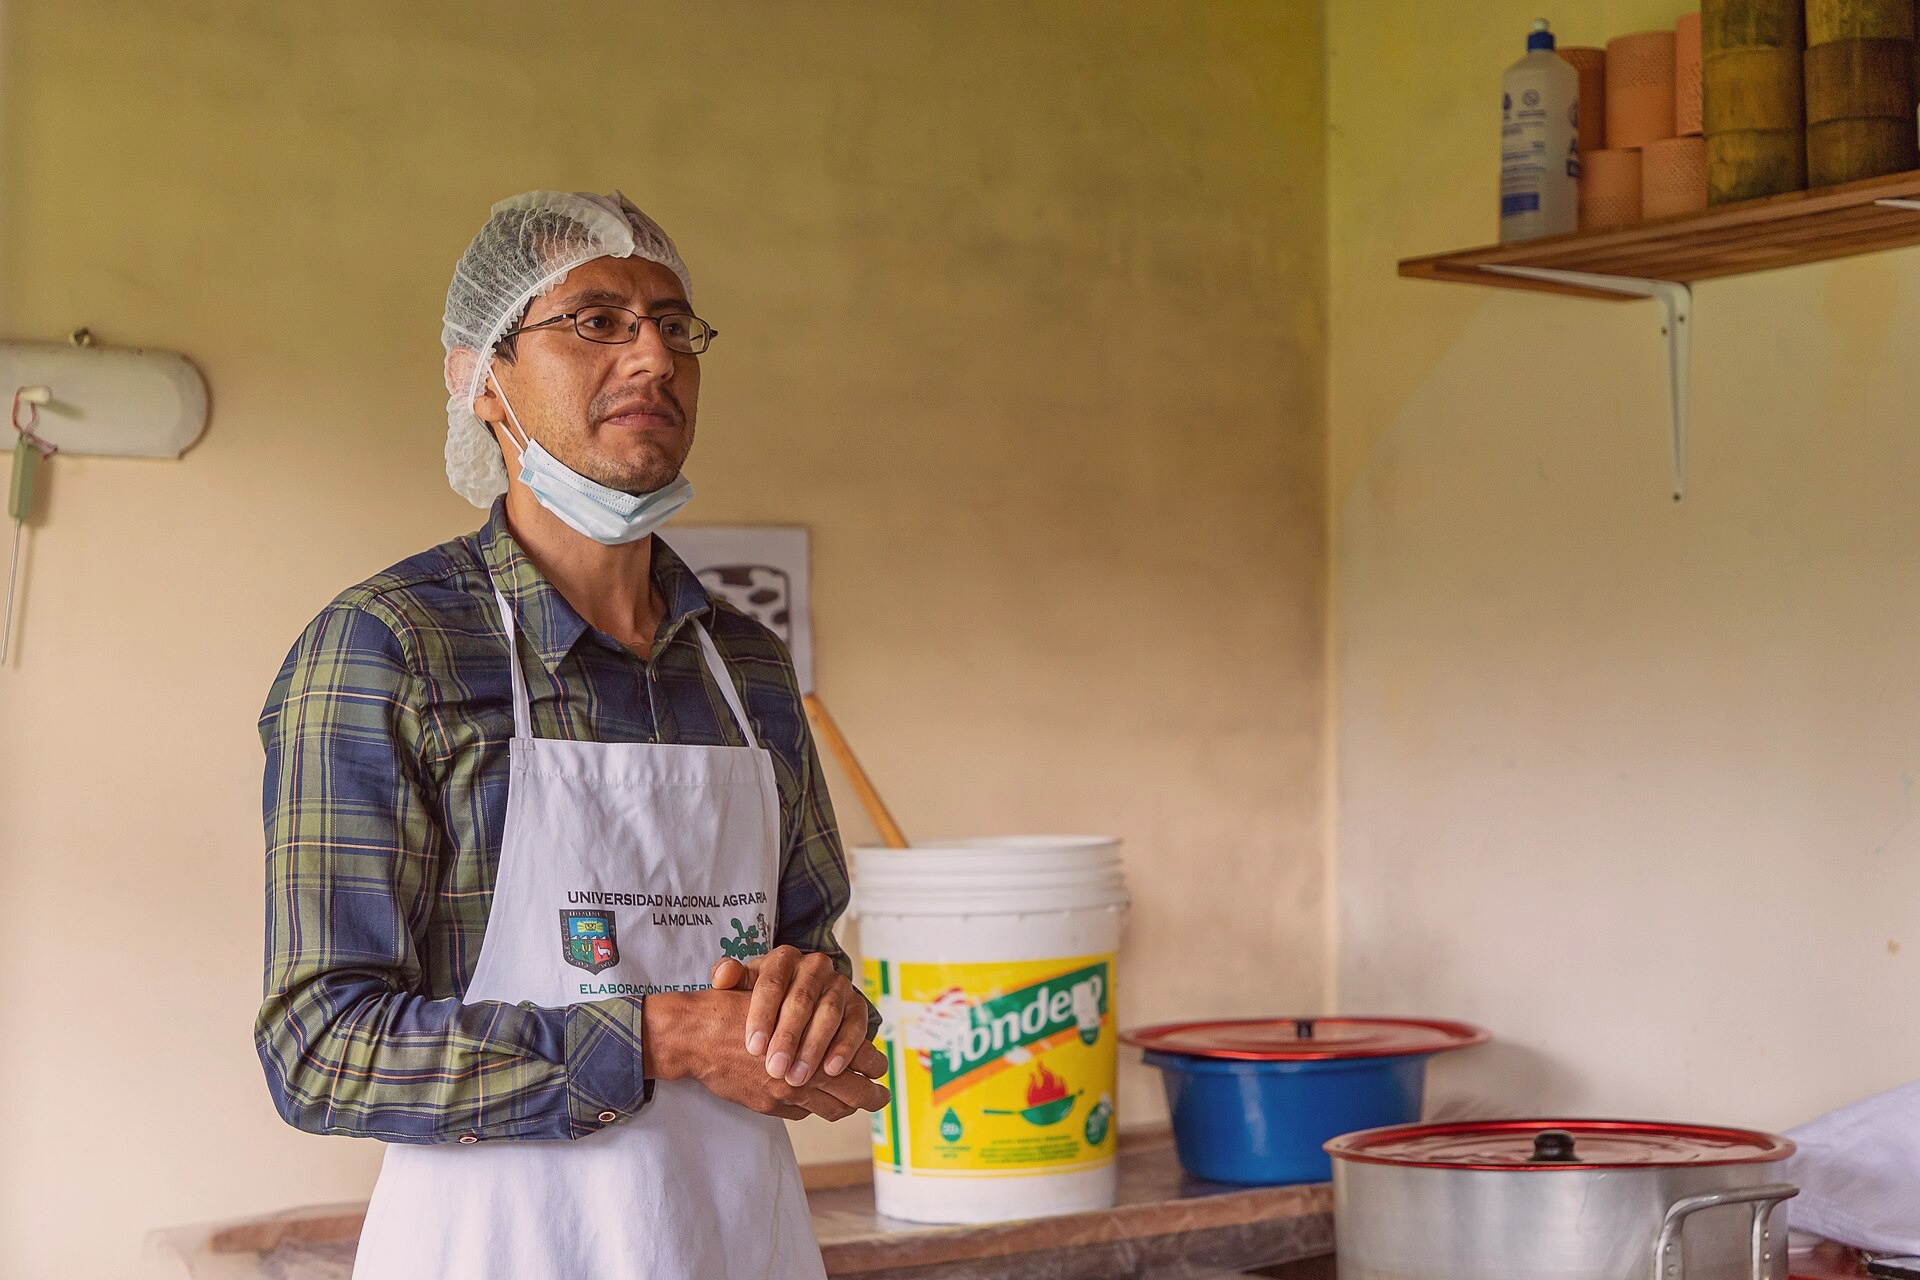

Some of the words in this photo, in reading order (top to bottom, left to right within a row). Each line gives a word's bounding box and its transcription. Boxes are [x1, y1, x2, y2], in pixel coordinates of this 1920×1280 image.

[568, 890, 662, 908] UNIVERSIDAD
[664, 895, 720, 909] NACIONAL
[652, 913, 667, 926] LA
[669, 913, 713, 927] MOLINA
[579, 982, 661, 995] ELABORACIÓN
[664, 984, 680, 993] DE
